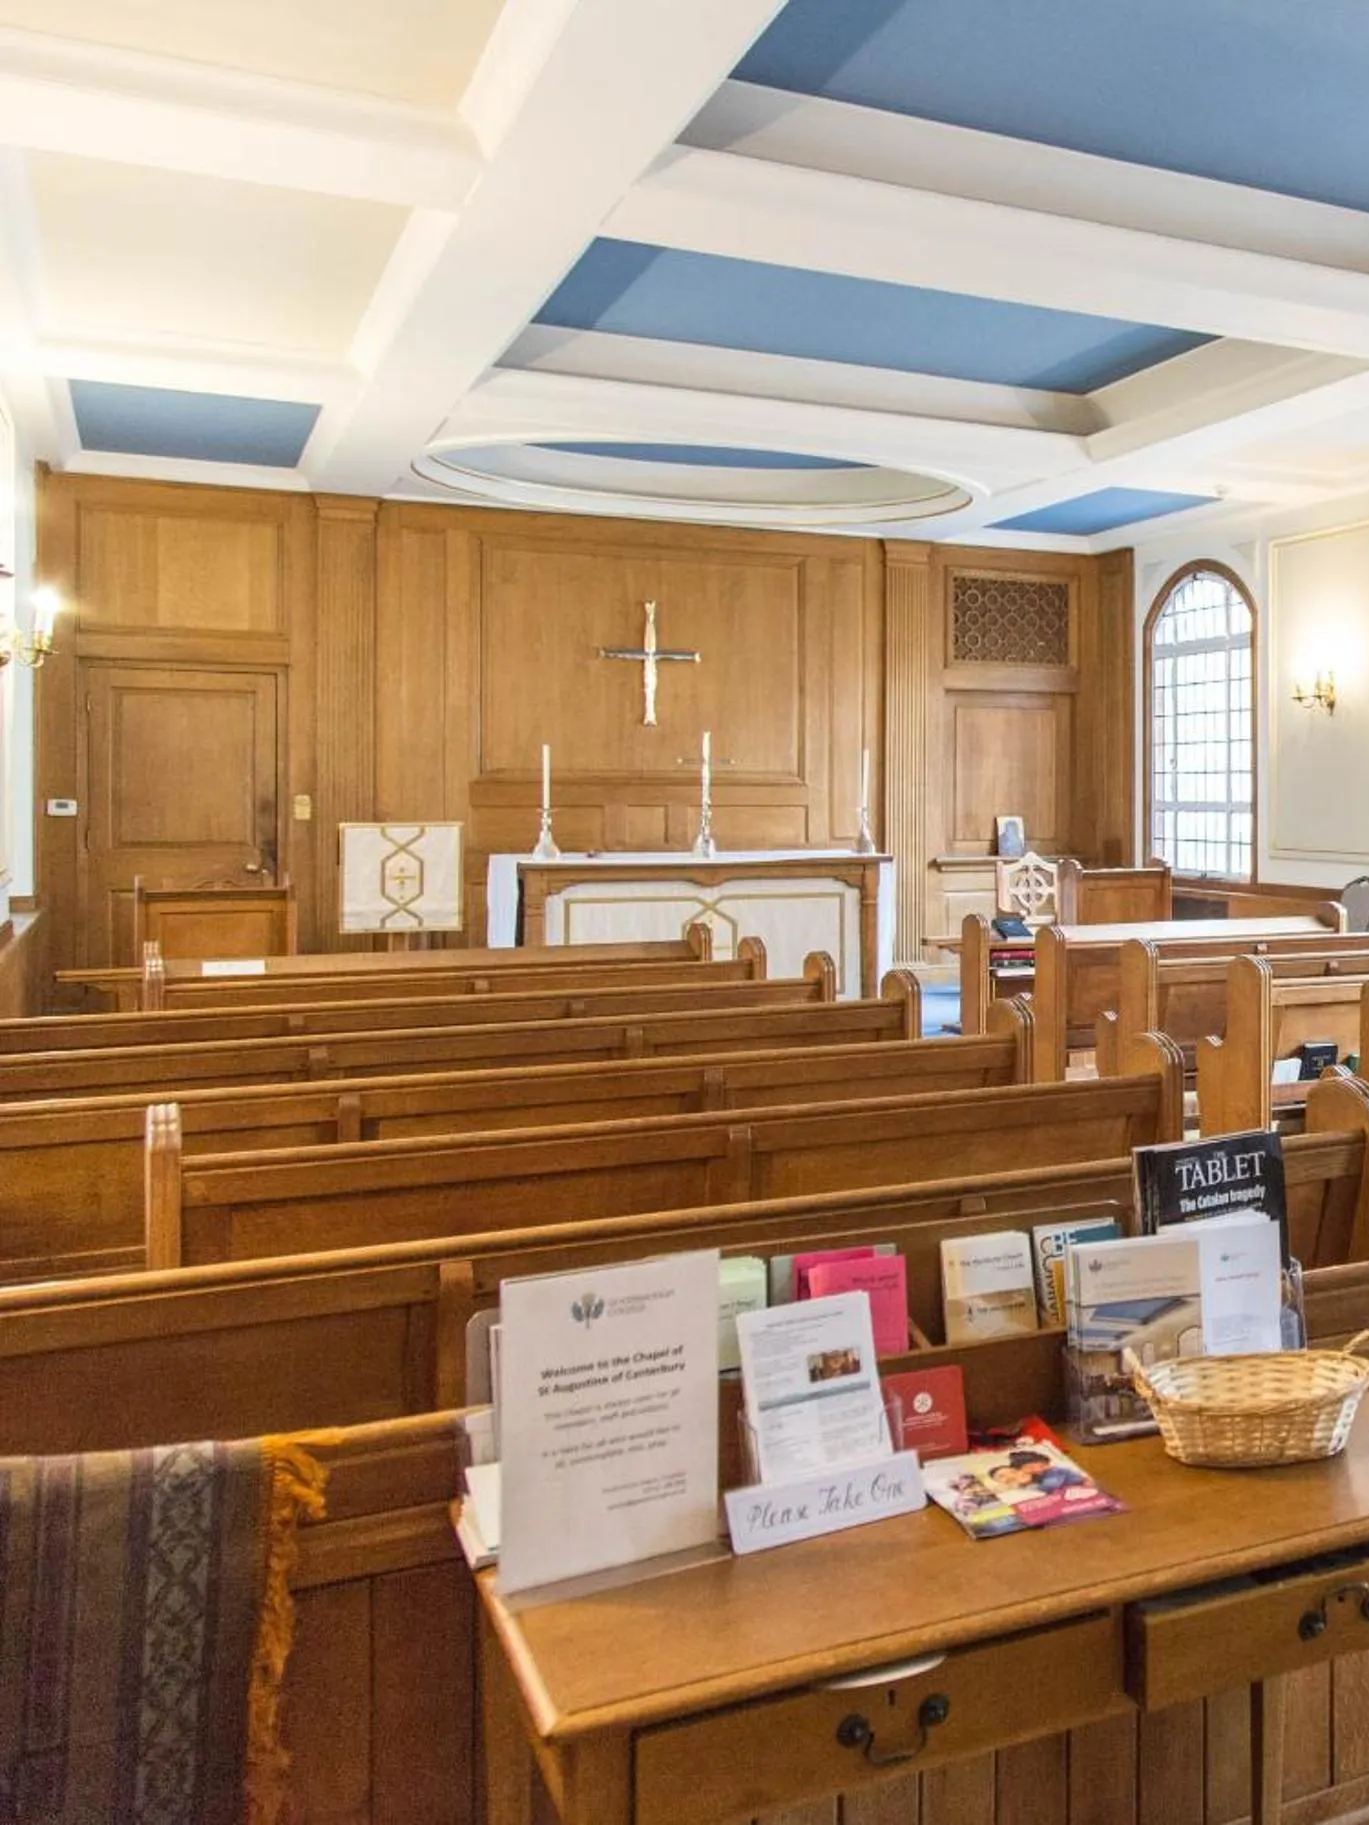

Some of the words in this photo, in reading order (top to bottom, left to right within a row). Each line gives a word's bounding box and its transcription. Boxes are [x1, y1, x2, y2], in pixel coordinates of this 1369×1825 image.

[1175, 1151, 1266, 1192] TABLET
[1179, 1197, 1197, 1213] The
[1197, 1191, 1230, 1209] Catalan
[1229, 1184, 1266, 1203] tragedy
[537, 1385, 549, 1397] St
[552, 1374, 609, 1394] Augustine
[611, 1371, 624, 1383] of
[625, 1361, 686, 1381] Canterbury
[540, 1361, 595, 1380] Welcome
[597, 1358, 609, 1371] to
[612, 1352, 631, 1367] the
[633, 1348, 670, 1366] Chapel
[671, 1345, 684, 1356] of
[746, 1501, 809, 1532] Please
[817, 1481, 863, 1517] Take
[870, 1473, 905, 1502] One
